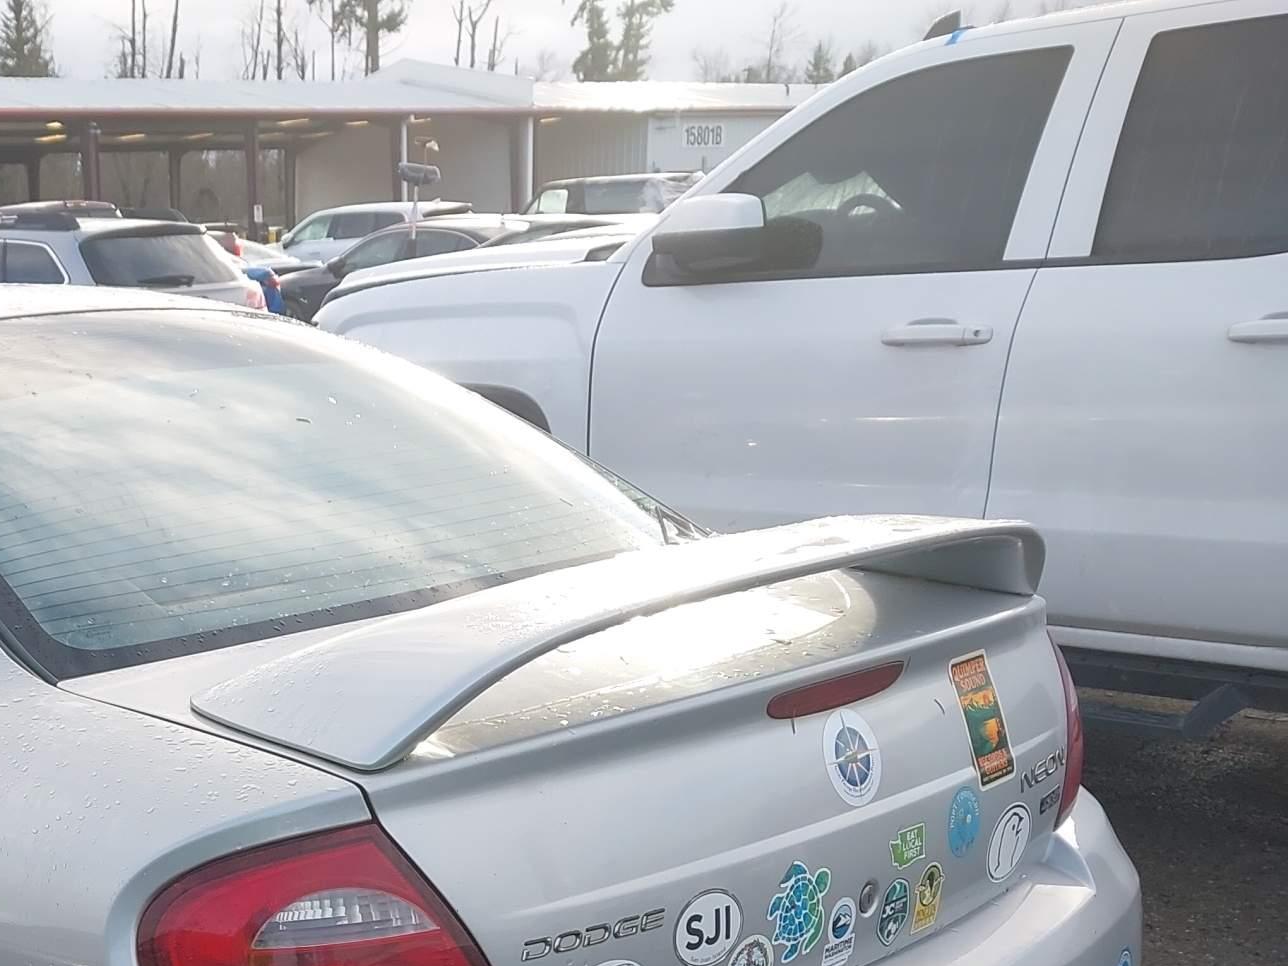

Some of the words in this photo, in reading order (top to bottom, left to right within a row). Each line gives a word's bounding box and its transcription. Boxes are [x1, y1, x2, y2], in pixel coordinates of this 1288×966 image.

[1020, 747, 1065, 793] NEON
[902, 837, 922, 852] LOCAL
[907, 829, 918, 841] EAT
[903, 847, 920, 861] FIRST
[521, 908, 665, 961] DODGE
[686, 905, 731, 950] SJI
